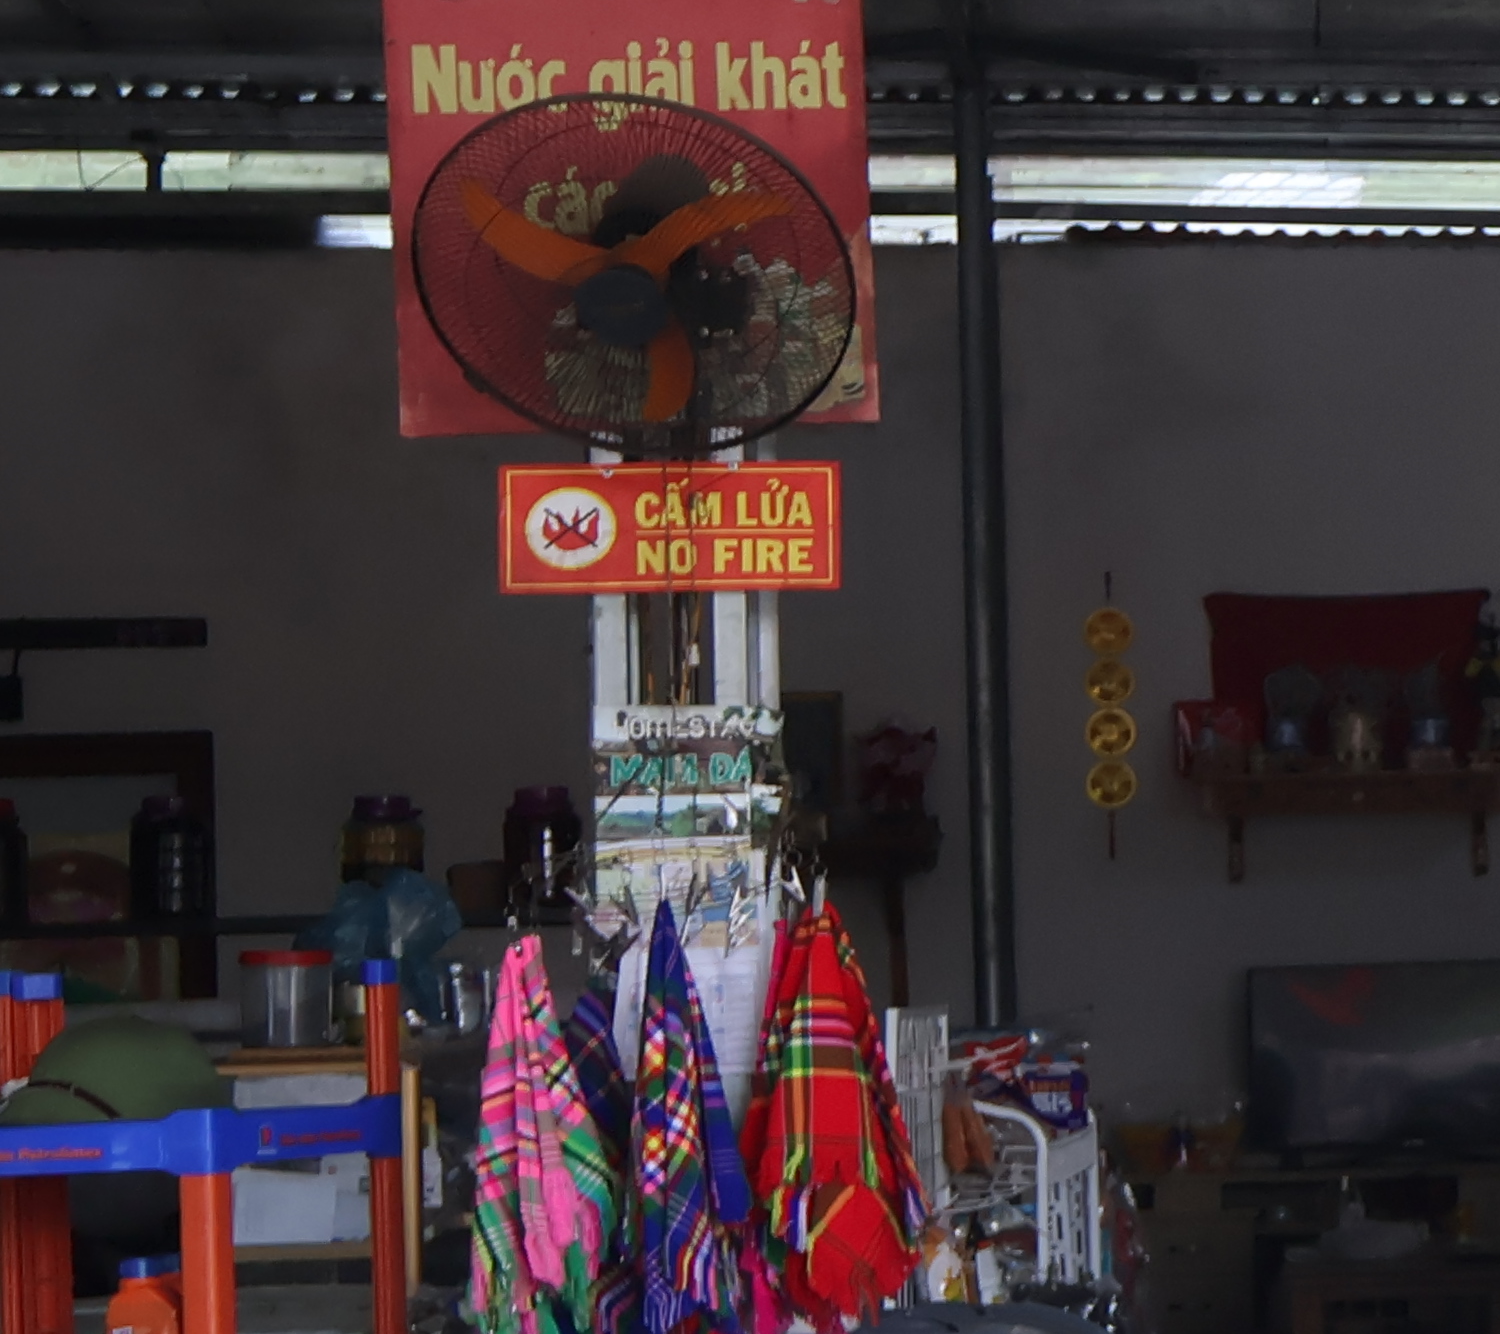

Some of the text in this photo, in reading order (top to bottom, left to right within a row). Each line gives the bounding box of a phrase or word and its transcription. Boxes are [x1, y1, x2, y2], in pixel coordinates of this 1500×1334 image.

[412, 37, 845, 130] Nước giải khát
[634, 477, 813, 529] CẤM LỬA
[636, 537, 813, 575] NO FIRE
